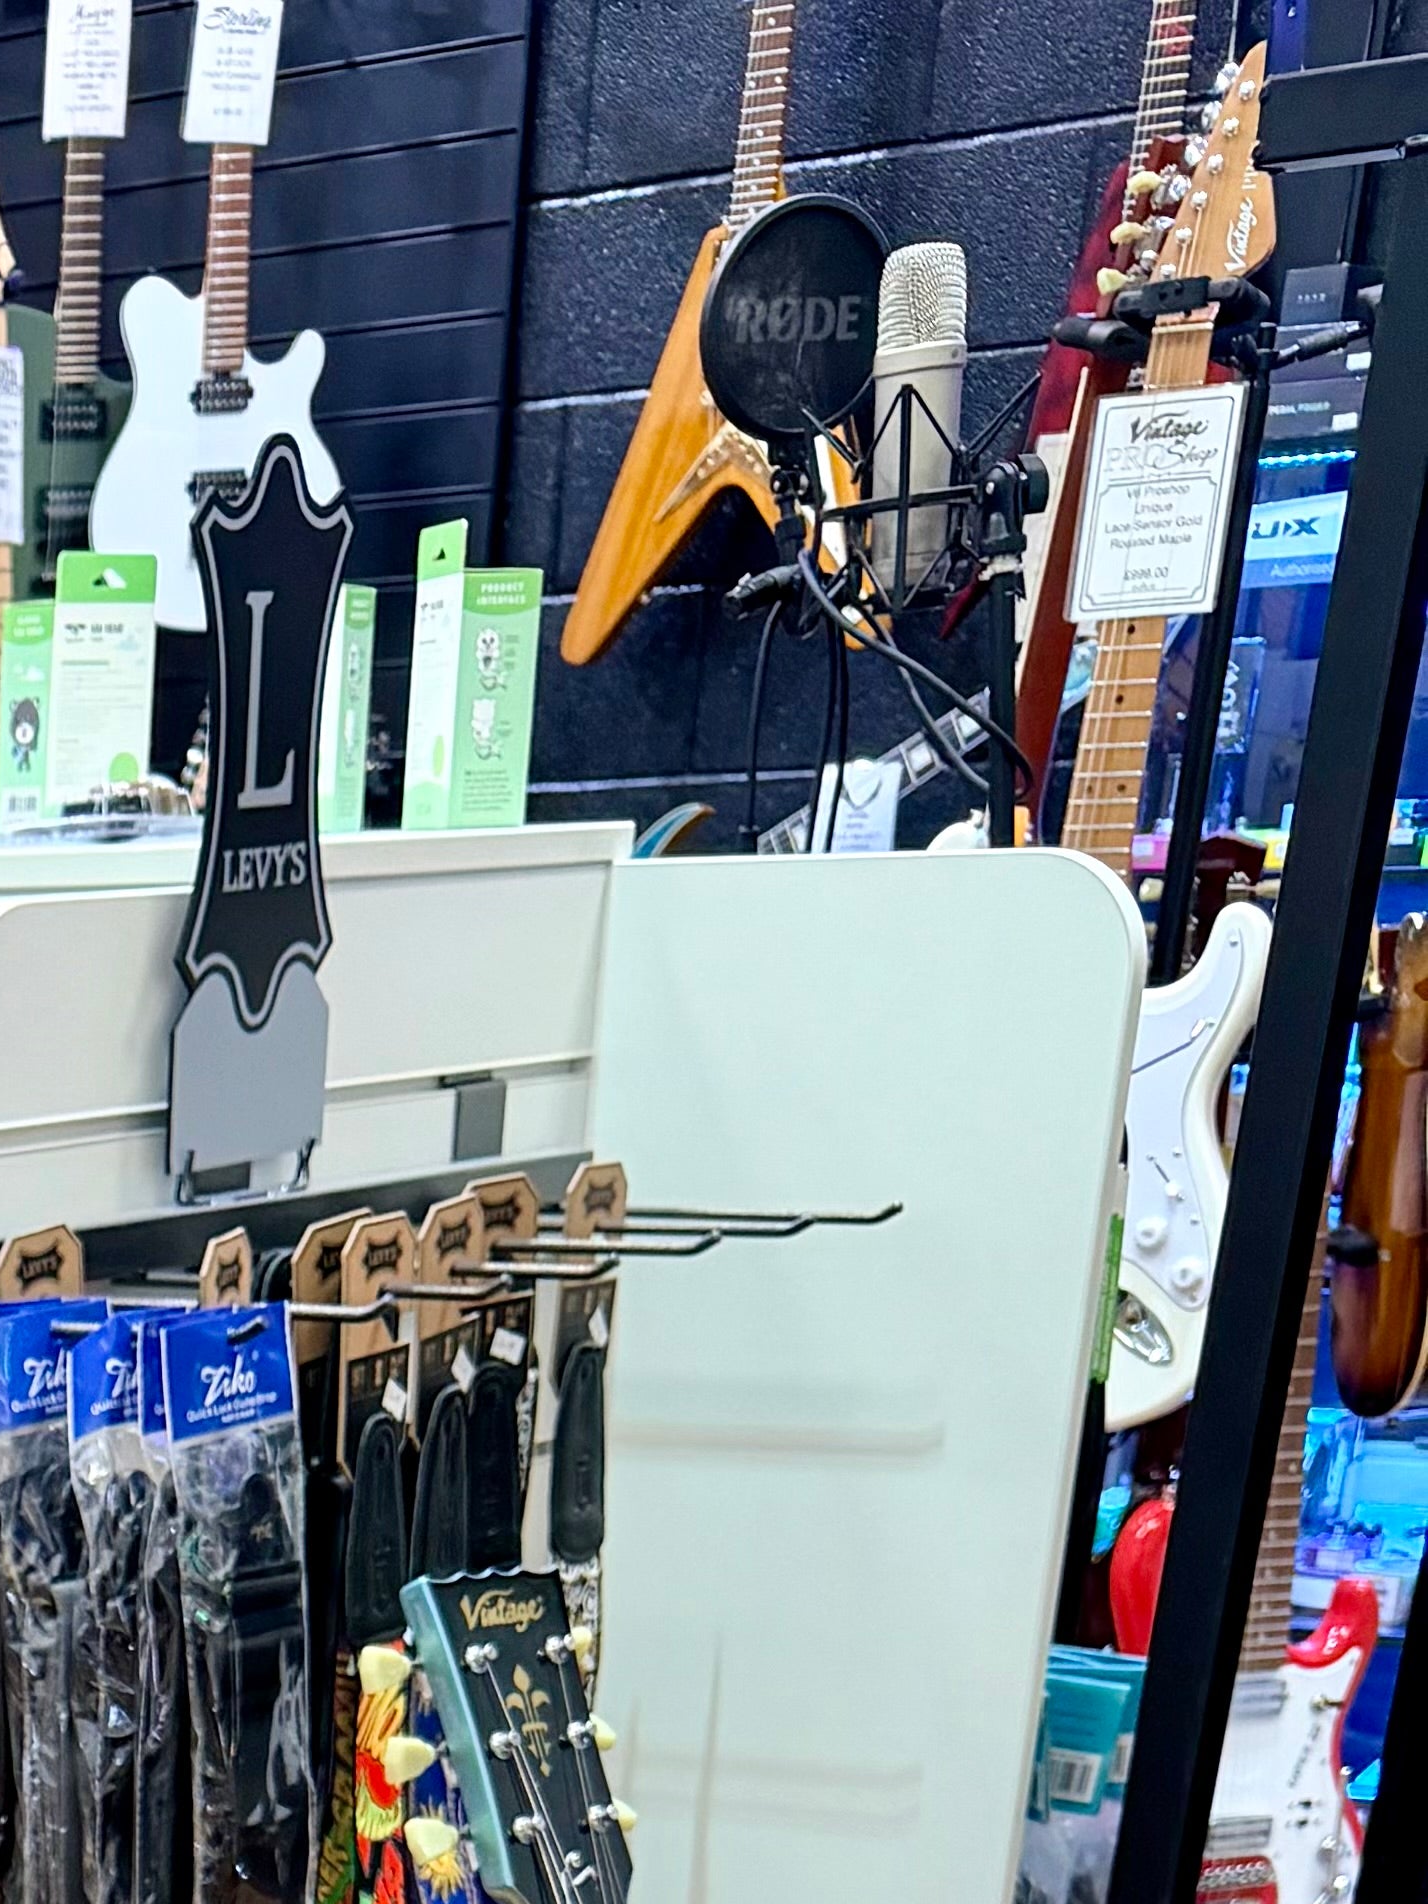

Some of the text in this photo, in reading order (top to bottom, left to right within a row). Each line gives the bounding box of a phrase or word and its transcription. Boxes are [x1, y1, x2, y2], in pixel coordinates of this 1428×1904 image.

[1130, 410, 1210, 445] Vintage
[1251, 517, 1321, 539] UX
[222, 840, 308, 894] LEVY'S
[24, 1347, 66, 1398] Zik
[460, 1586, 547, 1633] Vintage
